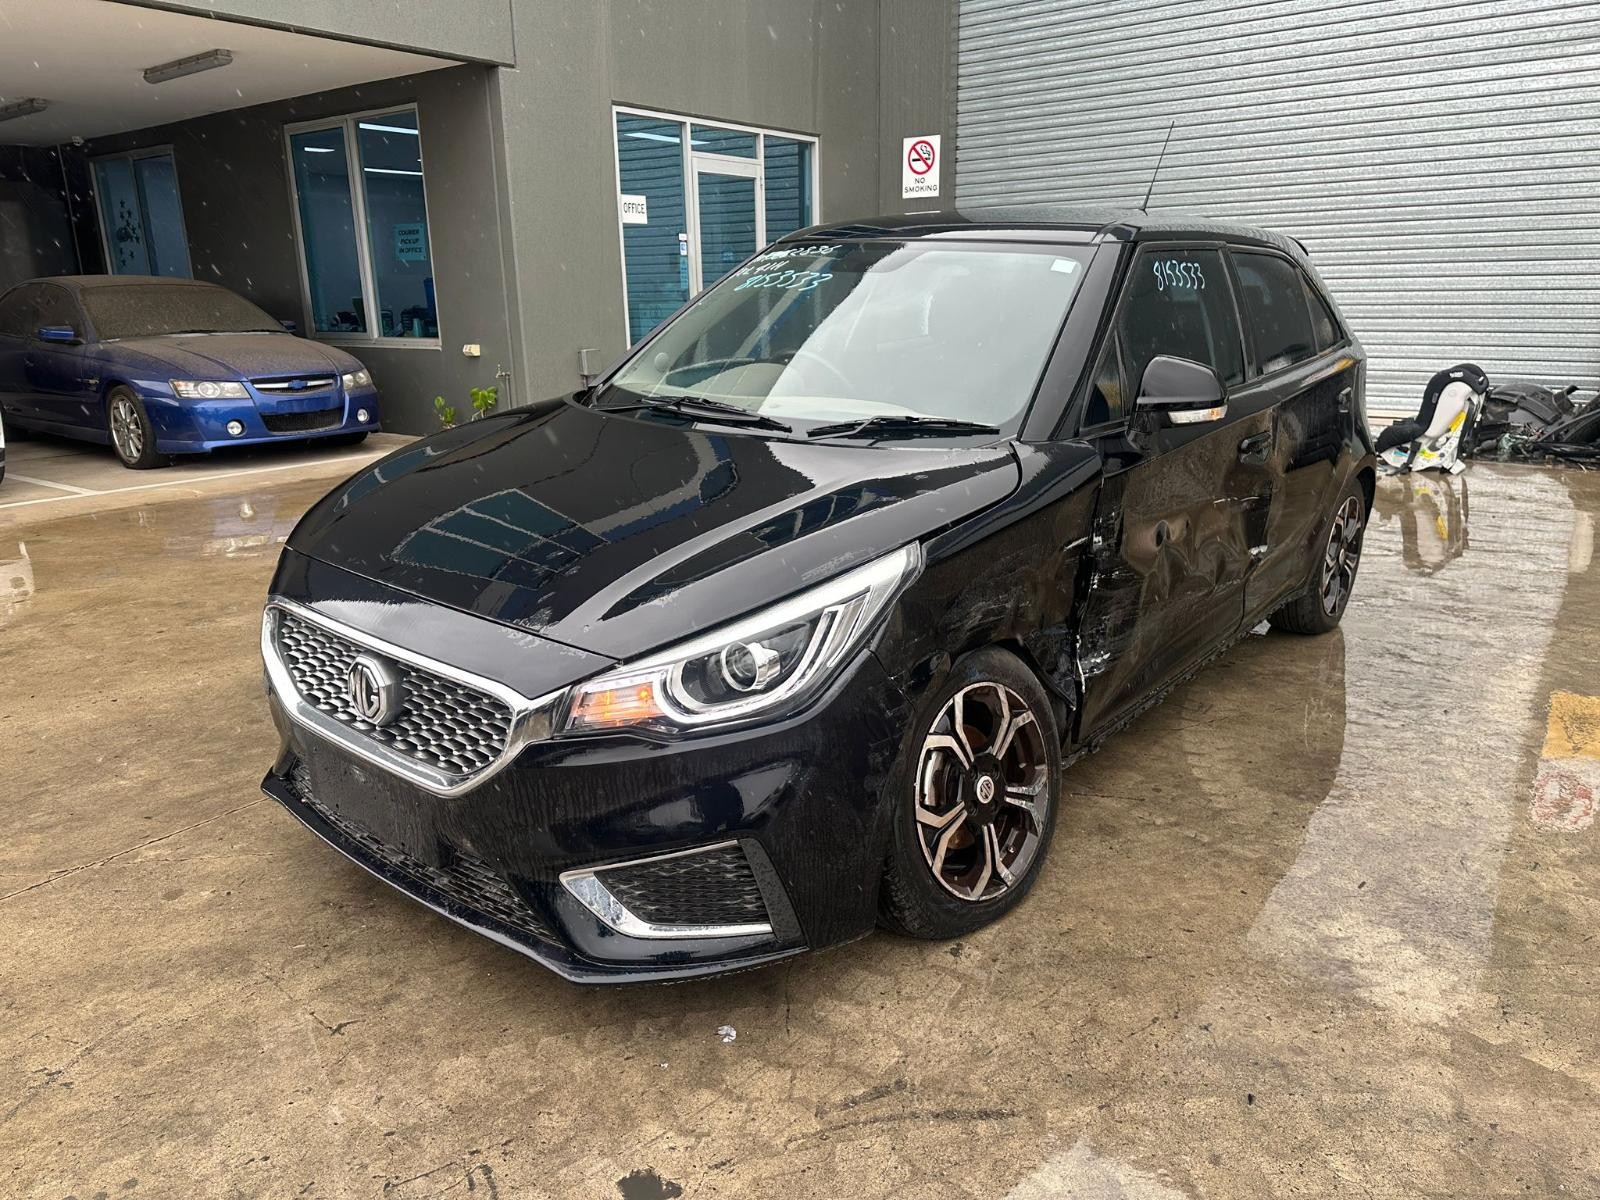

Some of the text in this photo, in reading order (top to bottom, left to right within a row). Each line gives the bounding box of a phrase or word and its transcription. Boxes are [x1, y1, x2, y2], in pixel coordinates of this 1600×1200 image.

[904, 184, 938, 193] SMOKING
[623, 202, 645, 214] OFFICE
[734, 270, 833, 292] 8153533
[1153, 260, 1205, 291] 8153533
[348, 659, 383, 721] MG
